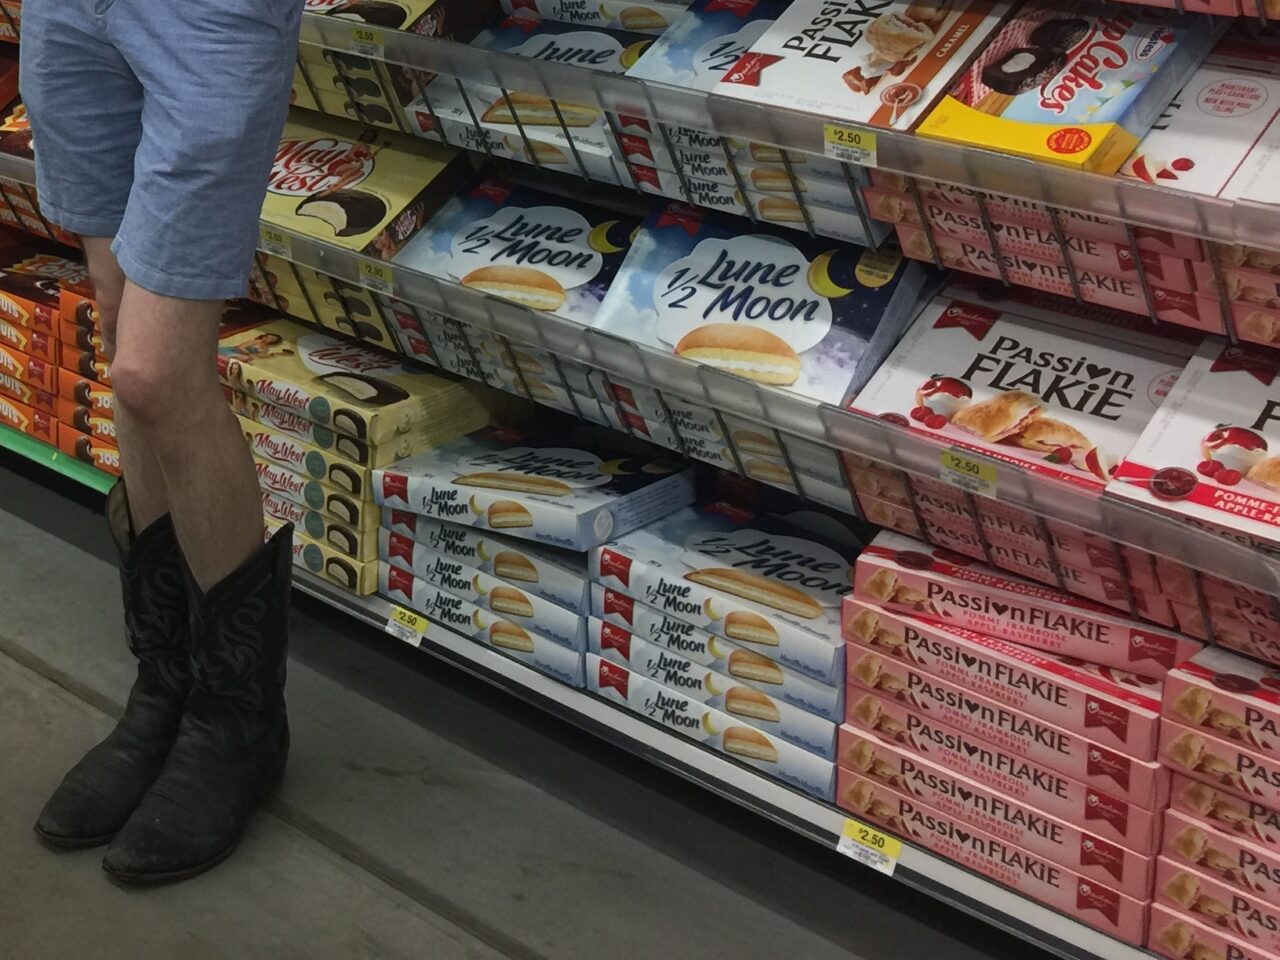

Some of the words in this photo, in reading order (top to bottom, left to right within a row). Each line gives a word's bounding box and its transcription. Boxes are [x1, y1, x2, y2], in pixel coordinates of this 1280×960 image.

[569, 9, 600, 22] Moon
[936, 23, 970, 58] CARAMEL
[834, 129, 861, 145] $2.50
[692, 163, 727, 177] Moon
[700, 191, 734, 205] Moon
[493, 214, 583, 243] Lune
[490, 240, 595, 269] Moon
[697, 249, 801, 288] Lune
[703, 286, 821, 322] Moon
[506, 449, 595, 469] Lune
[950, 455, 980, 475] $2.50
[503, 462, 605, 482] Moon
[430, 487, 457, 503] Lune
[437, 500, 468, 516] Moon
[439, 522, 466, 541] Lune
[444, 541, 475, 557] Moon
[734, 540, 840, 573] Lune
[435, 558, 462, 575] Lune
[440, 573, 471, 590] Moon
[657, 578, 691, 598] Lune
[434, 592, 462, 609] Lune
[663, 597, 701, 615] Moon
[440, 607, 471, 625] Moon
[660, 616, 694, 636] Lune
[667, 634, 705, 654] Moon
[657, 653, 691, 673] Lune
[664, 671, 702, 690] Moon
[655, 692, 688, 712] Lune
[662, 710, 699, 730] Moon
[859, 827, 885, 849] $2.50
